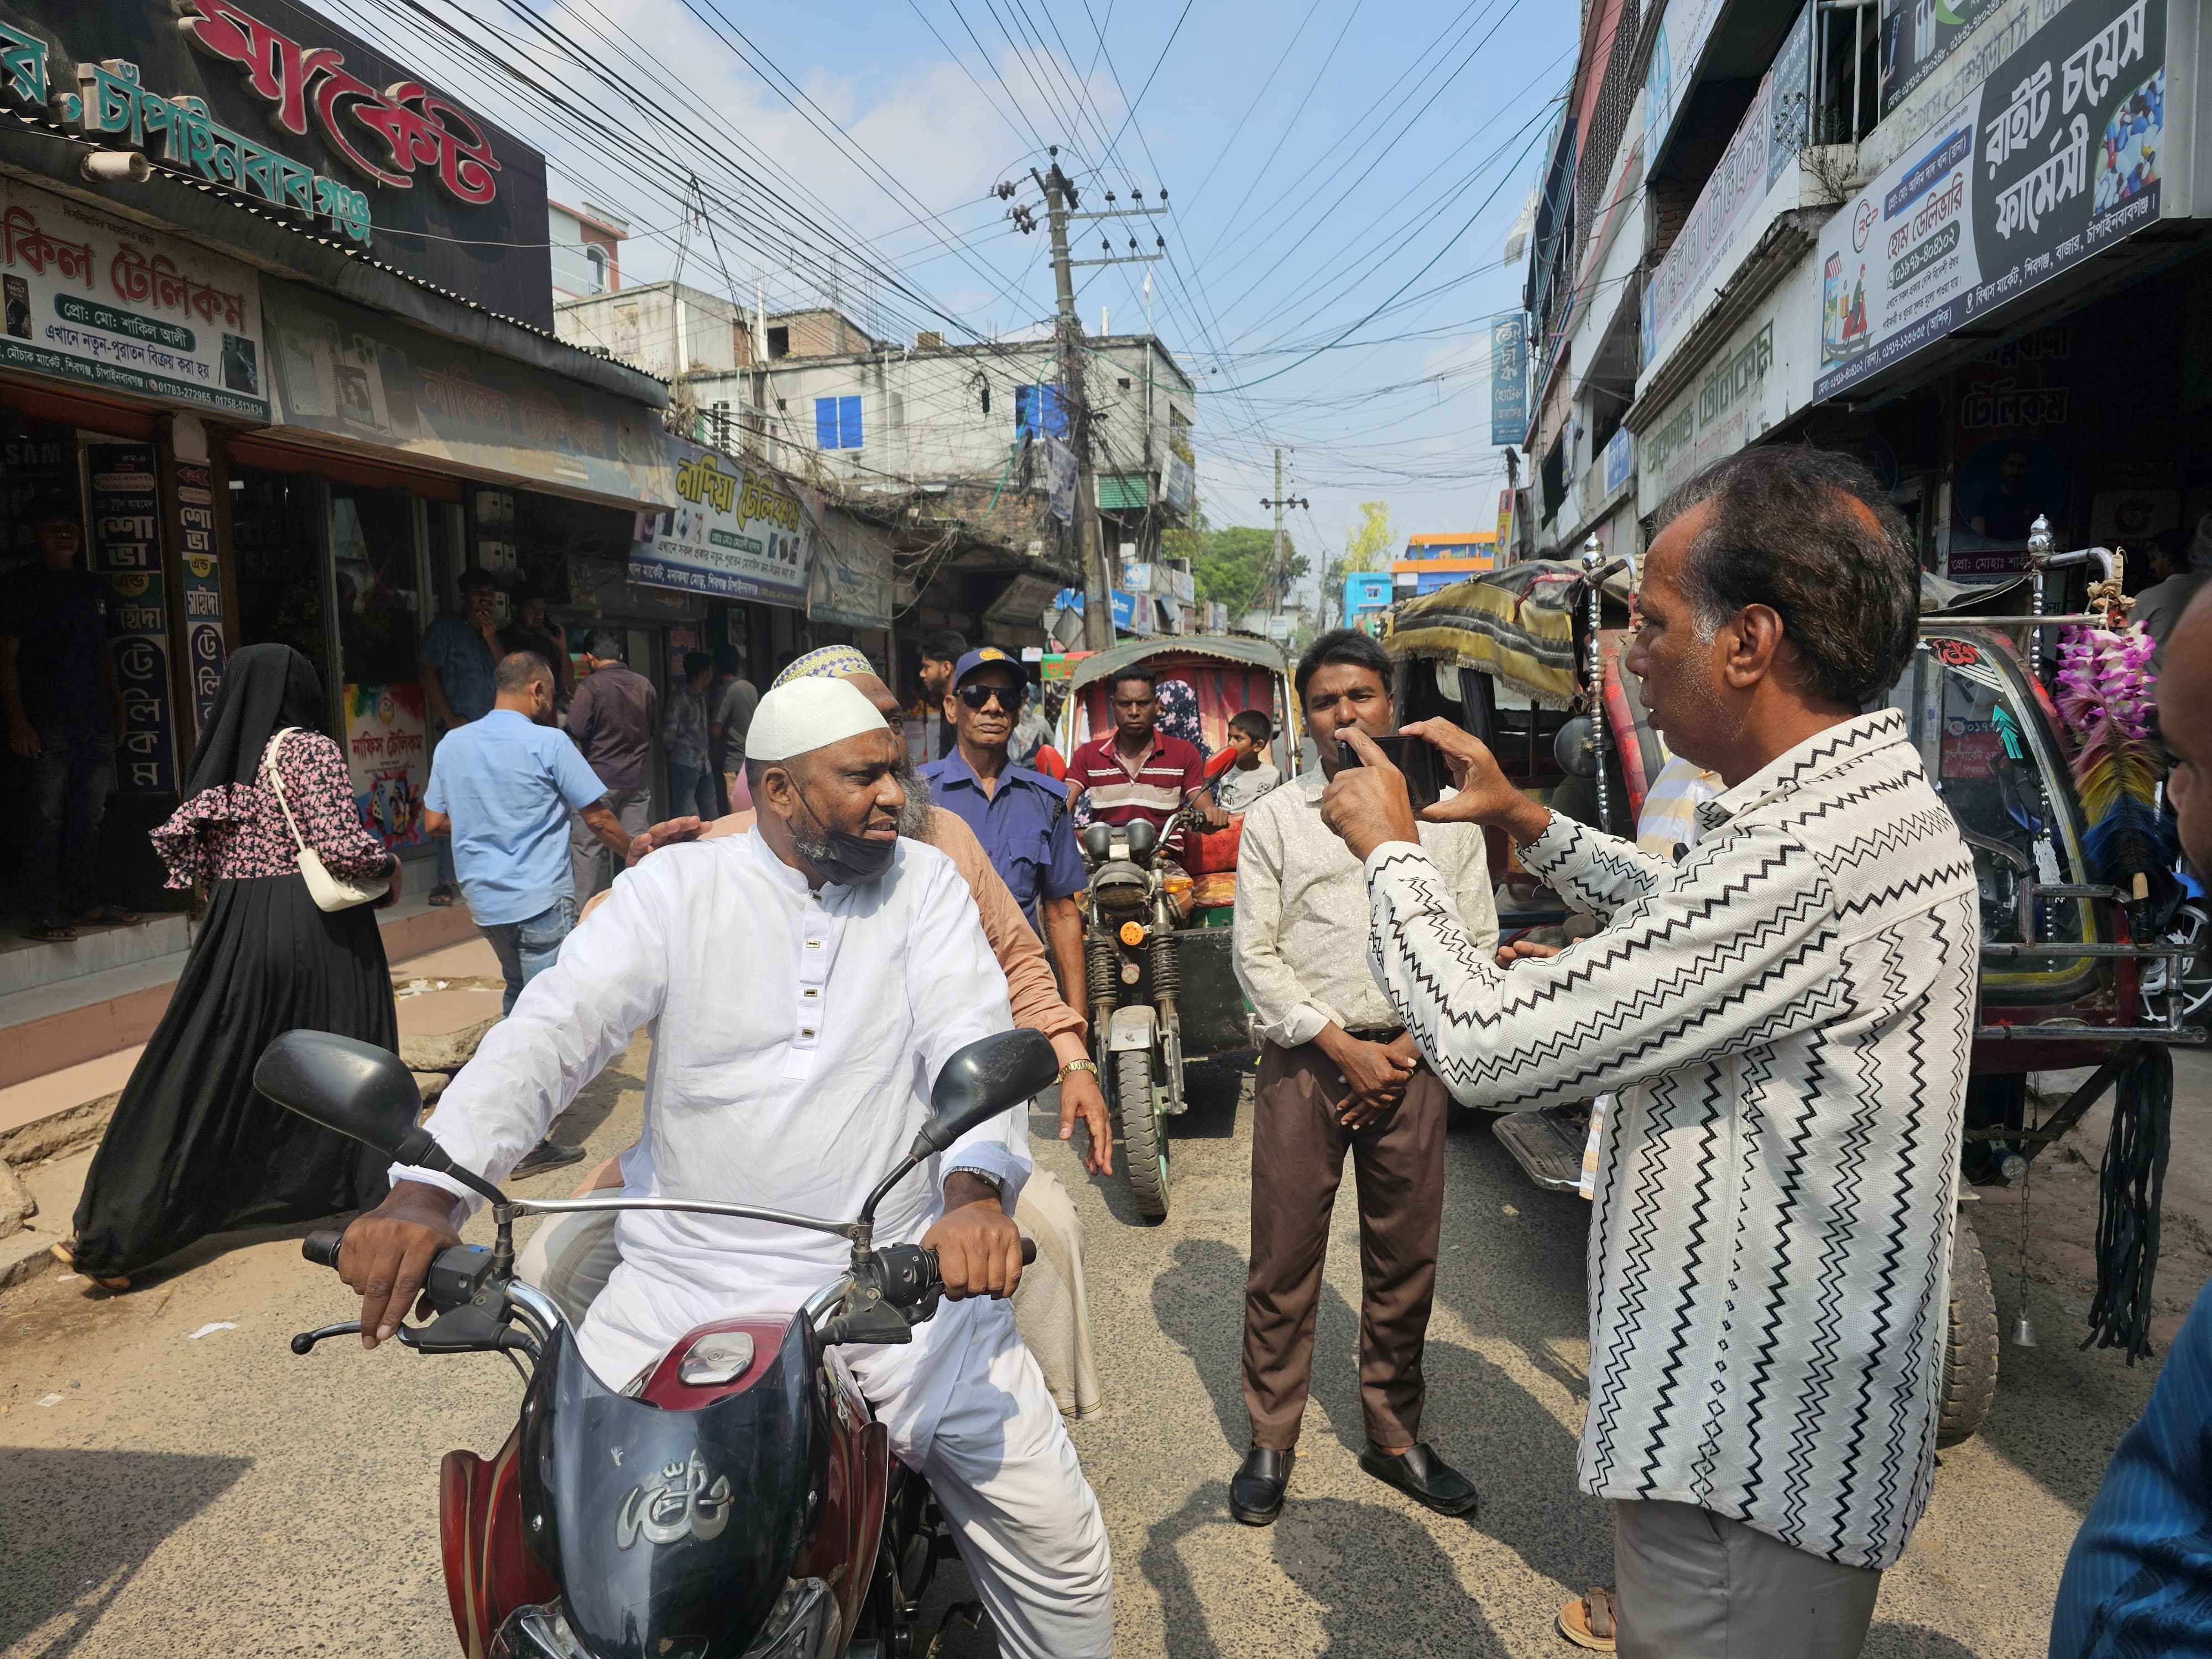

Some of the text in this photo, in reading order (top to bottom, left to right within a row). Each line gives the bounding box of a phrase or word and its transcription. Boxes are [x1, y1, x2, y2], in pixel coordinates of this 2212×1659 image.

[178, 0, 501, 204] মার্কেট
[1985, 59, 2053, 180] রাইট
[79, 59, 372, 247] চাঁপাইনবাবগঞ্জ
[1995, 113, 2091, 242] ফার্মেসী
[1888, 171, 1965, 260] হোম ডেলিভারি
[1895, 227, 1955, 281] ০১৯৭৯-৪০৪১০২
[0, 206, 247, 335] কিল টেলিকম
[1976, 282, 1995, 306] বিশ্বাস
[1997, 265, 2022, 295] মার্কেট,
[2025, 252, 2053, 279] শিবগঞ্জ,
[2056, 233, 2084, 261] বাজার,
[45, 324, 79, 349] এখানে
[147, 343, 174, 371] বিক্রয়
[176, 355, 195, 377] করা
[196, 362, 210, 381] হয়
[122, 316, 157, 340] শাকিল
[159, 326, 187, 348] আলী
[7, 346, 34, 364] মৌচাক
[215, 394, 264, 416] 01758-513434
[676, 452, 802, 533] নাদিয়া টেলিকম
[351, 728, 423, 761] নাফিস টেলিকম
